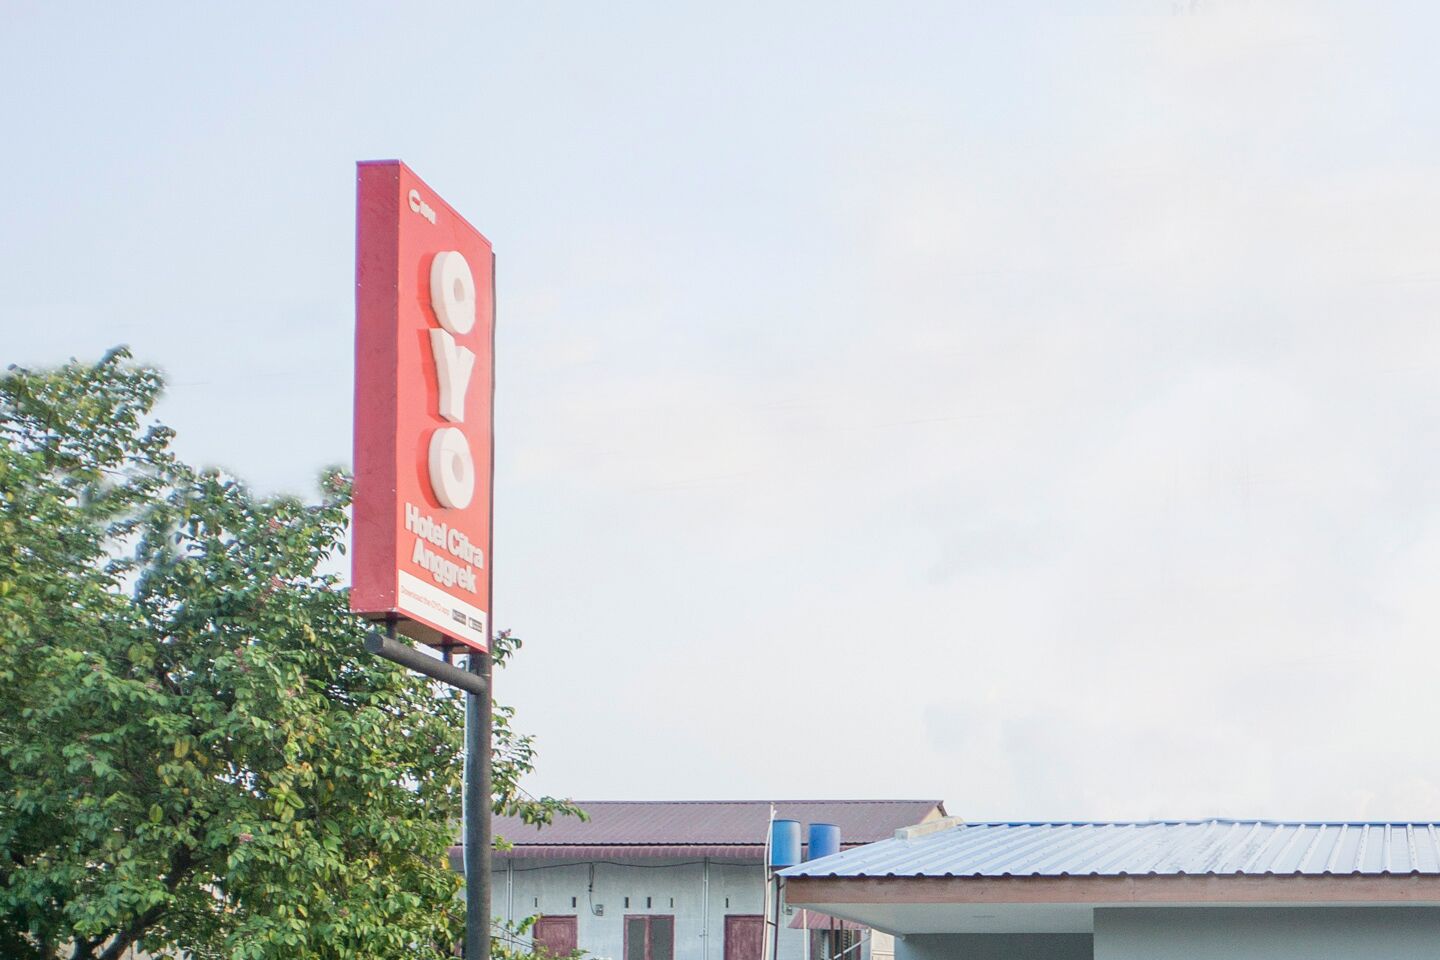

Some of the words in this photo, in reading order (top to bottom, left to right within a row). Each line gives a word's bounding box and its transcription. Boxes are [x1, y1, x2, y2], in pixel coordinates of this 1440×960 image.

[429, 250, 476, 510] OYO
[405, 502, 447, 549] Hotel
[447, 528, 484, 569] Citra
[412, 538, 477, 594] Anggrek
